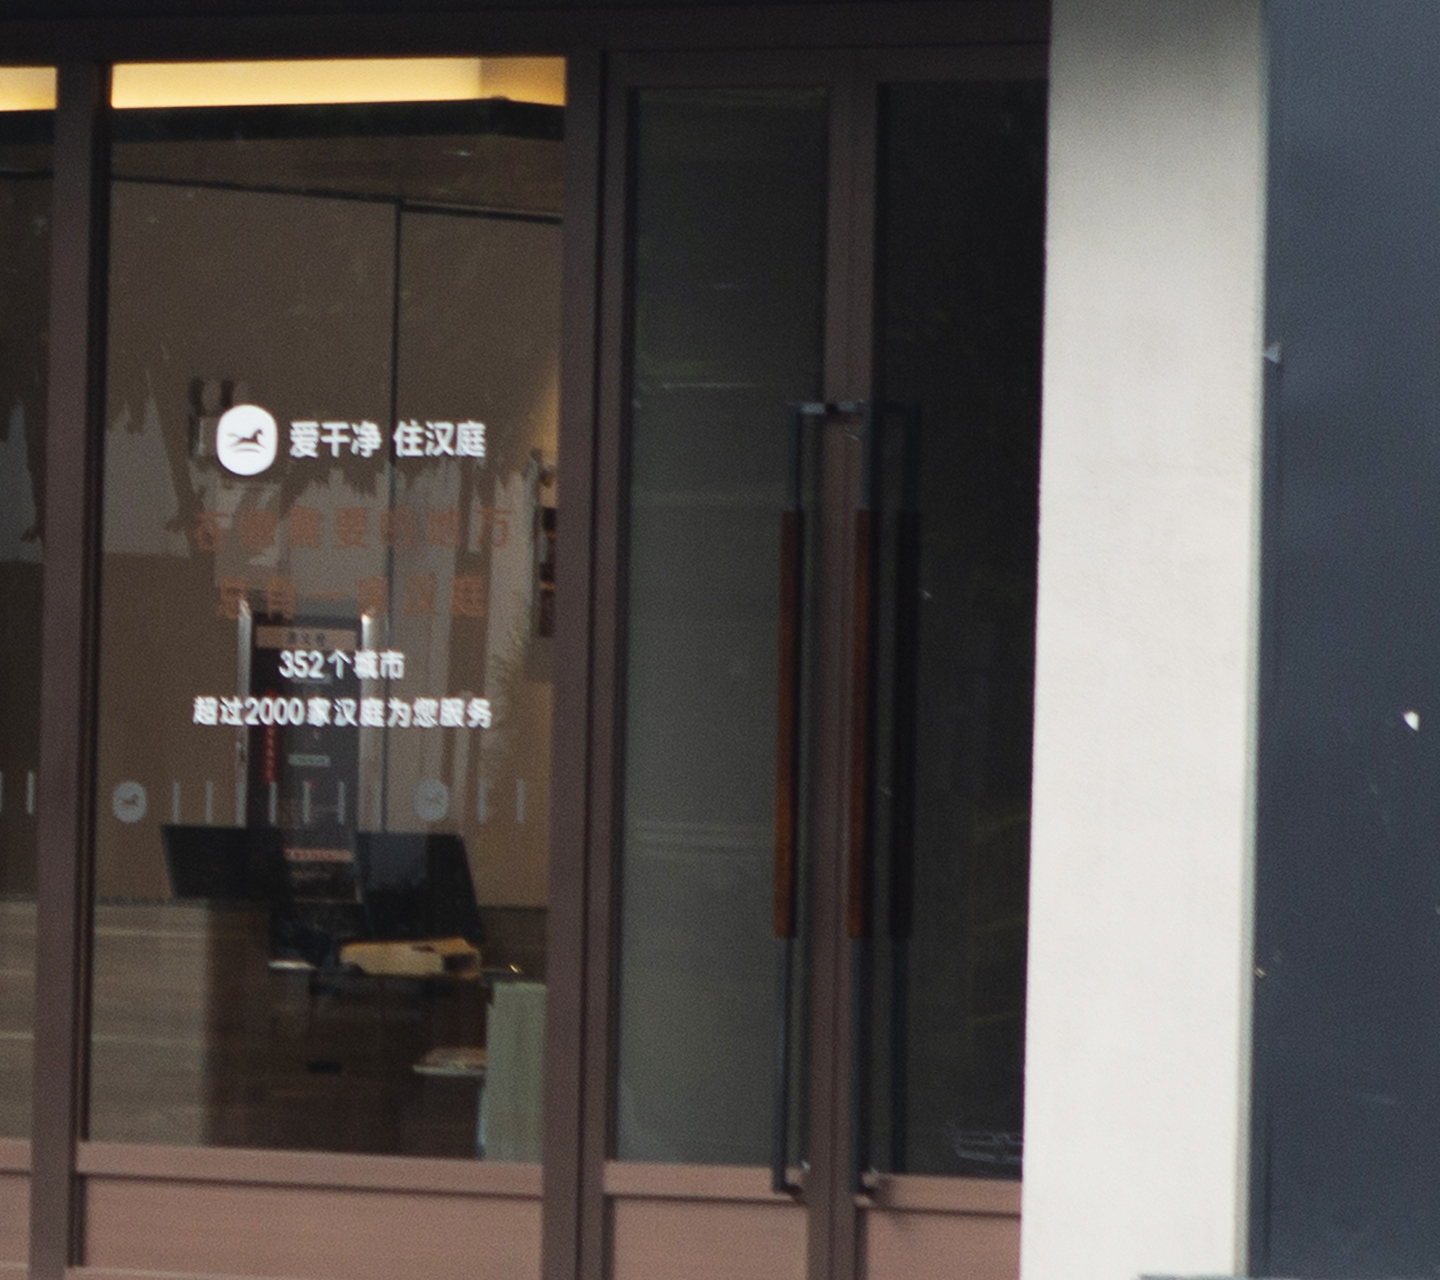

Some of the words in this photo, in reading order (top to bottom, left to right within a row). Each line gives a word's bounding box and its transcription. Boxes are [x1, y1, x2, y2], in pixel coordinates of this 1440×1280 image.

[289, 420, 383, 458] 爱干净
[393, 419, 486, 458] 住汉庭
[278, 649, 406, 680] 352个城市
[192, 696, 493, 729] 超过2000家汉庭为您服务
